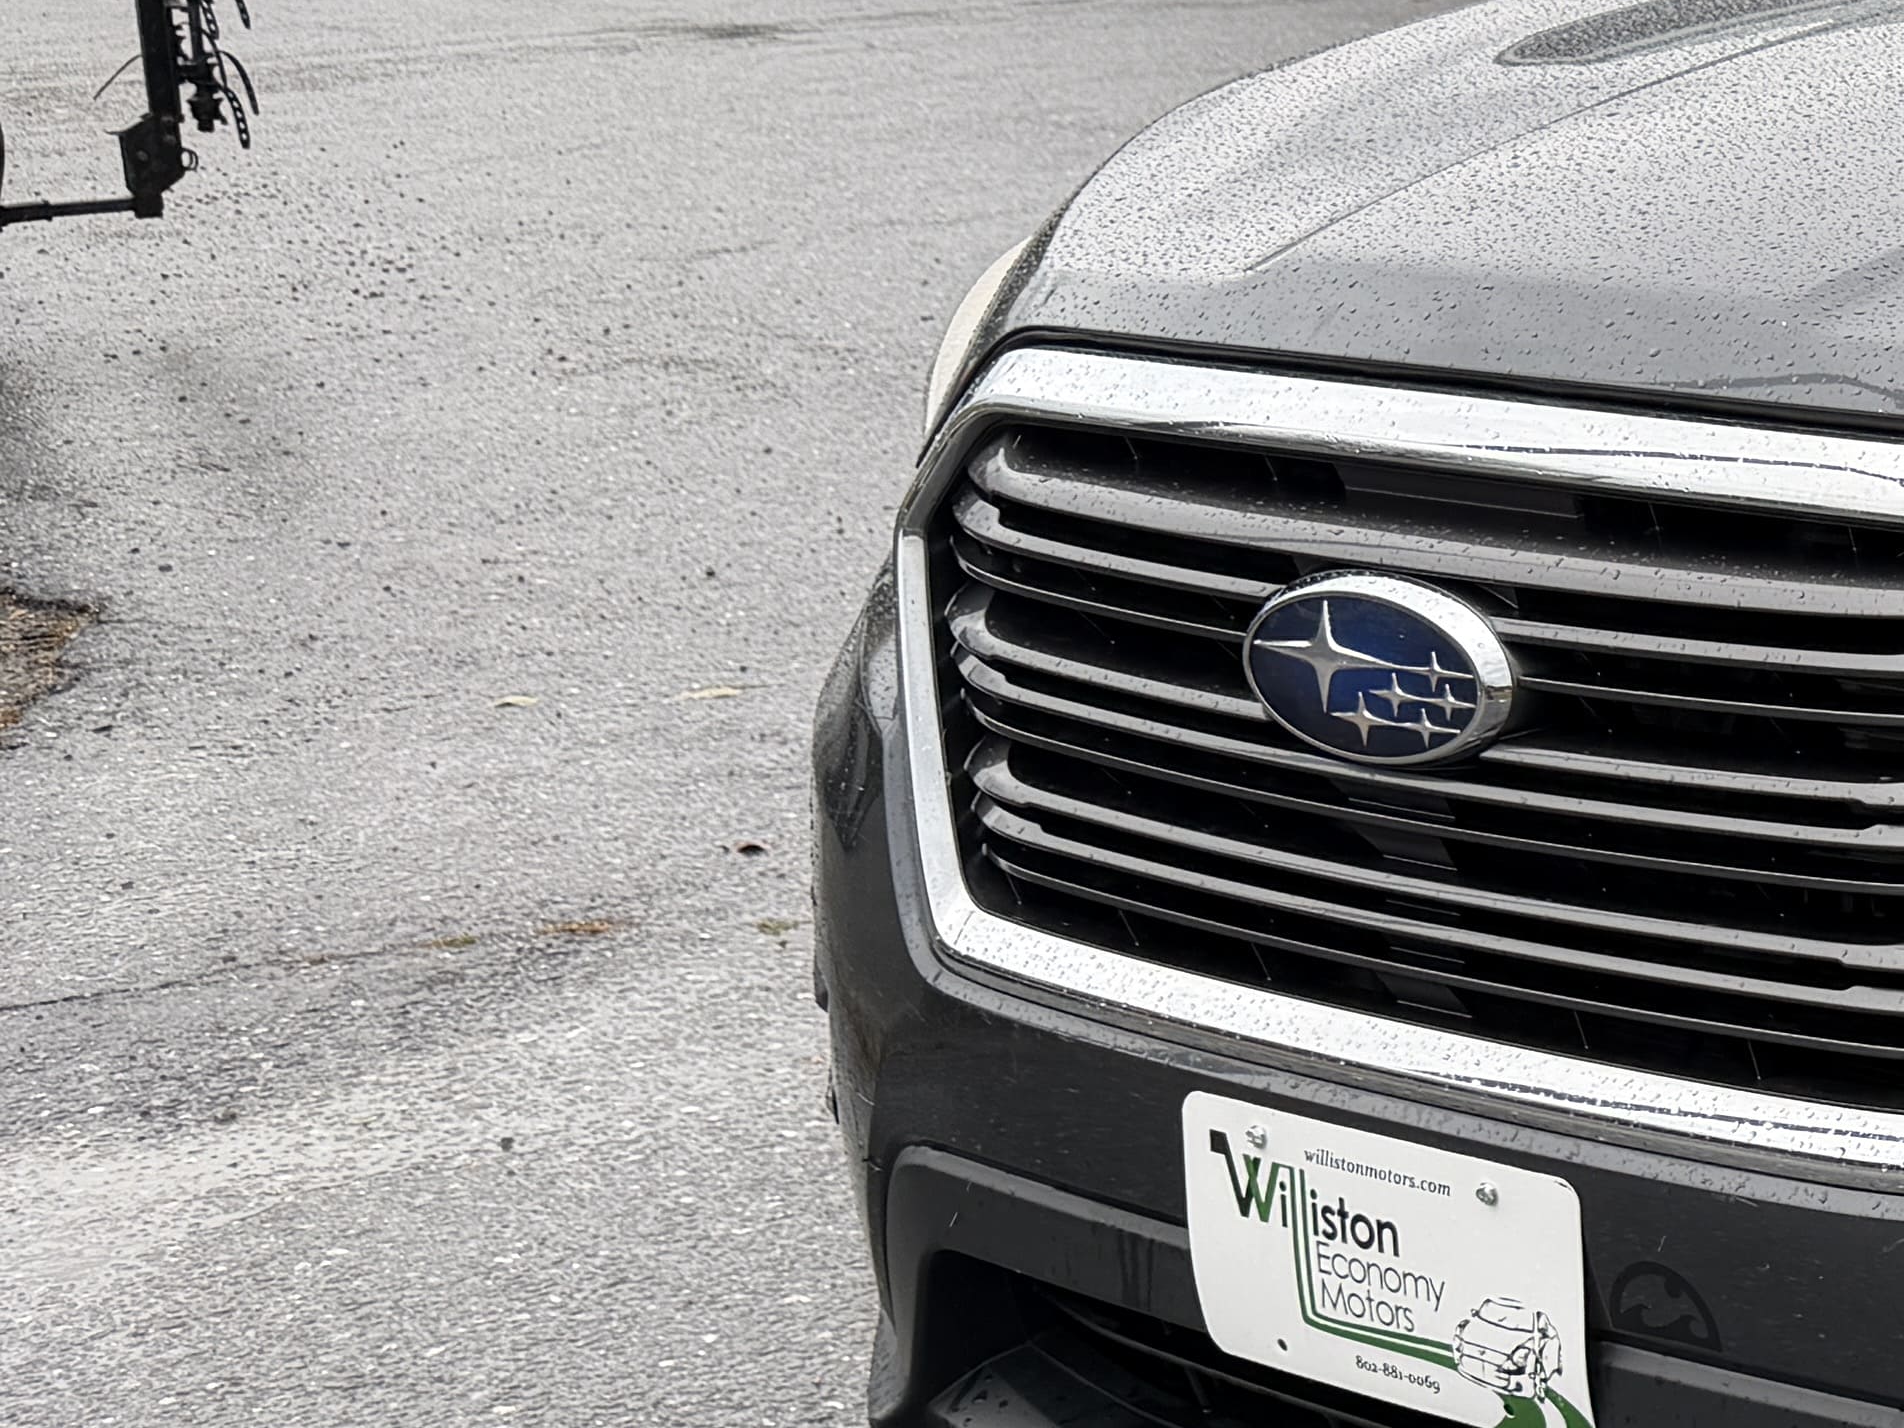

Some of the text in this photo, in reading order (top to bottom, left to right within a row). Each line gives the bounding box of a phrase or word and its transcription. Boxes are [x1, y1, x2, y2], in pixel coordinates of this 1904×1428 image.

[1209, 1129, 1400, 1257] Williston
[1304, 1149, 1451, 1197] willistonmotors.com
[1316, 1240, 1445, 1312] Economy
[1321, 1278, 1415, 1332] Motors
[1355, 1355, 1441, 1394] 802-881-0069
